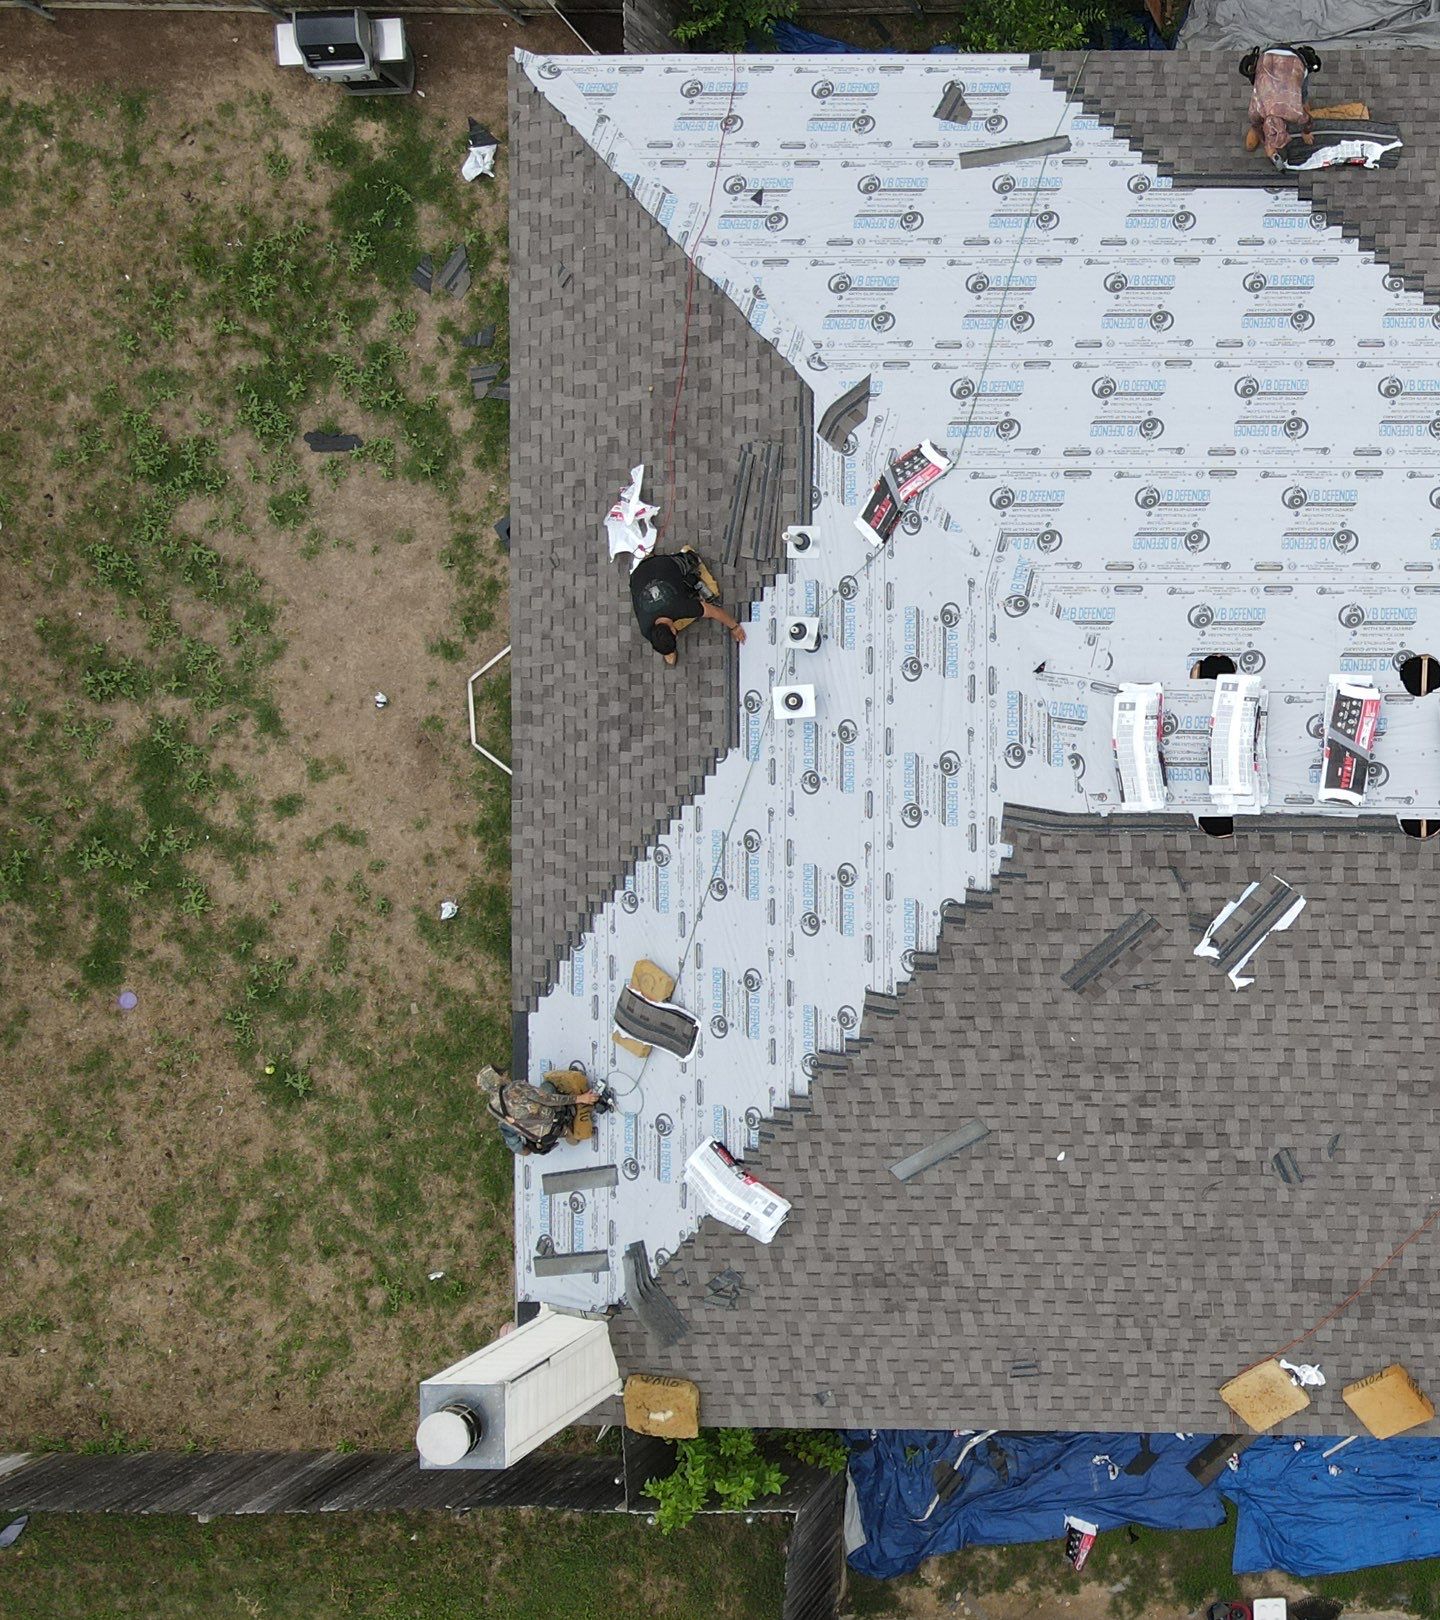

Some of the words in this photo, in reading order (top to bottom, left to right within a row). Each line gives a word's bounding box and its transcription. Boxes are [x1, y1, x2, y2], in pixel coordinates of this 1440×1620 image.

[1125, 218, 1159, 228] DEFENDER
[1142, 275, 1176, 286] DEFENDER
[1280, 275, 1314, 285] DEFENDER
[1101, 318, 1136, 329] DEFENDER
[1241, 317, 1276, 328] DEFENDER
[1274, 379, 1309, 390] DEFENDER
[1378, 425, 1414, 436] DEFENDER
[1175, 490, 1211, 501] DEFENDER
[1322, 489, 1358, 501] DEFENDER
[1134, 538, 1170, 549] DEFENDER
[1281, 538, 1318, 550] DEFENDER
[904, 606, 915, 642] DEFENDER
[1229, 608, 1265, 620] DEFENDER
[1380, 607, 1418, 620] DEFENDER
[845, 615, 856, 650] DEFENDER
[947, 642, 958, 678] DEFENDER
[1007, 691, 1018, 728] DEFENDER
[804, 722, 814, 756] DEFENDER
[844, 759, 855, 794] DEFENDER
[903, 752, 914, 788] DEFENDER
[1341, 756, 1353, 788] TITAN
[947, 791, 958, 827] DEFENDER
[749, 867, 760, 900] DEFENDER
[803, 863, 813, 898] DEFENDER
[844, 901, 854, 936] DEFENDER
[750, 1005, 760, 1038] DEFENDER
